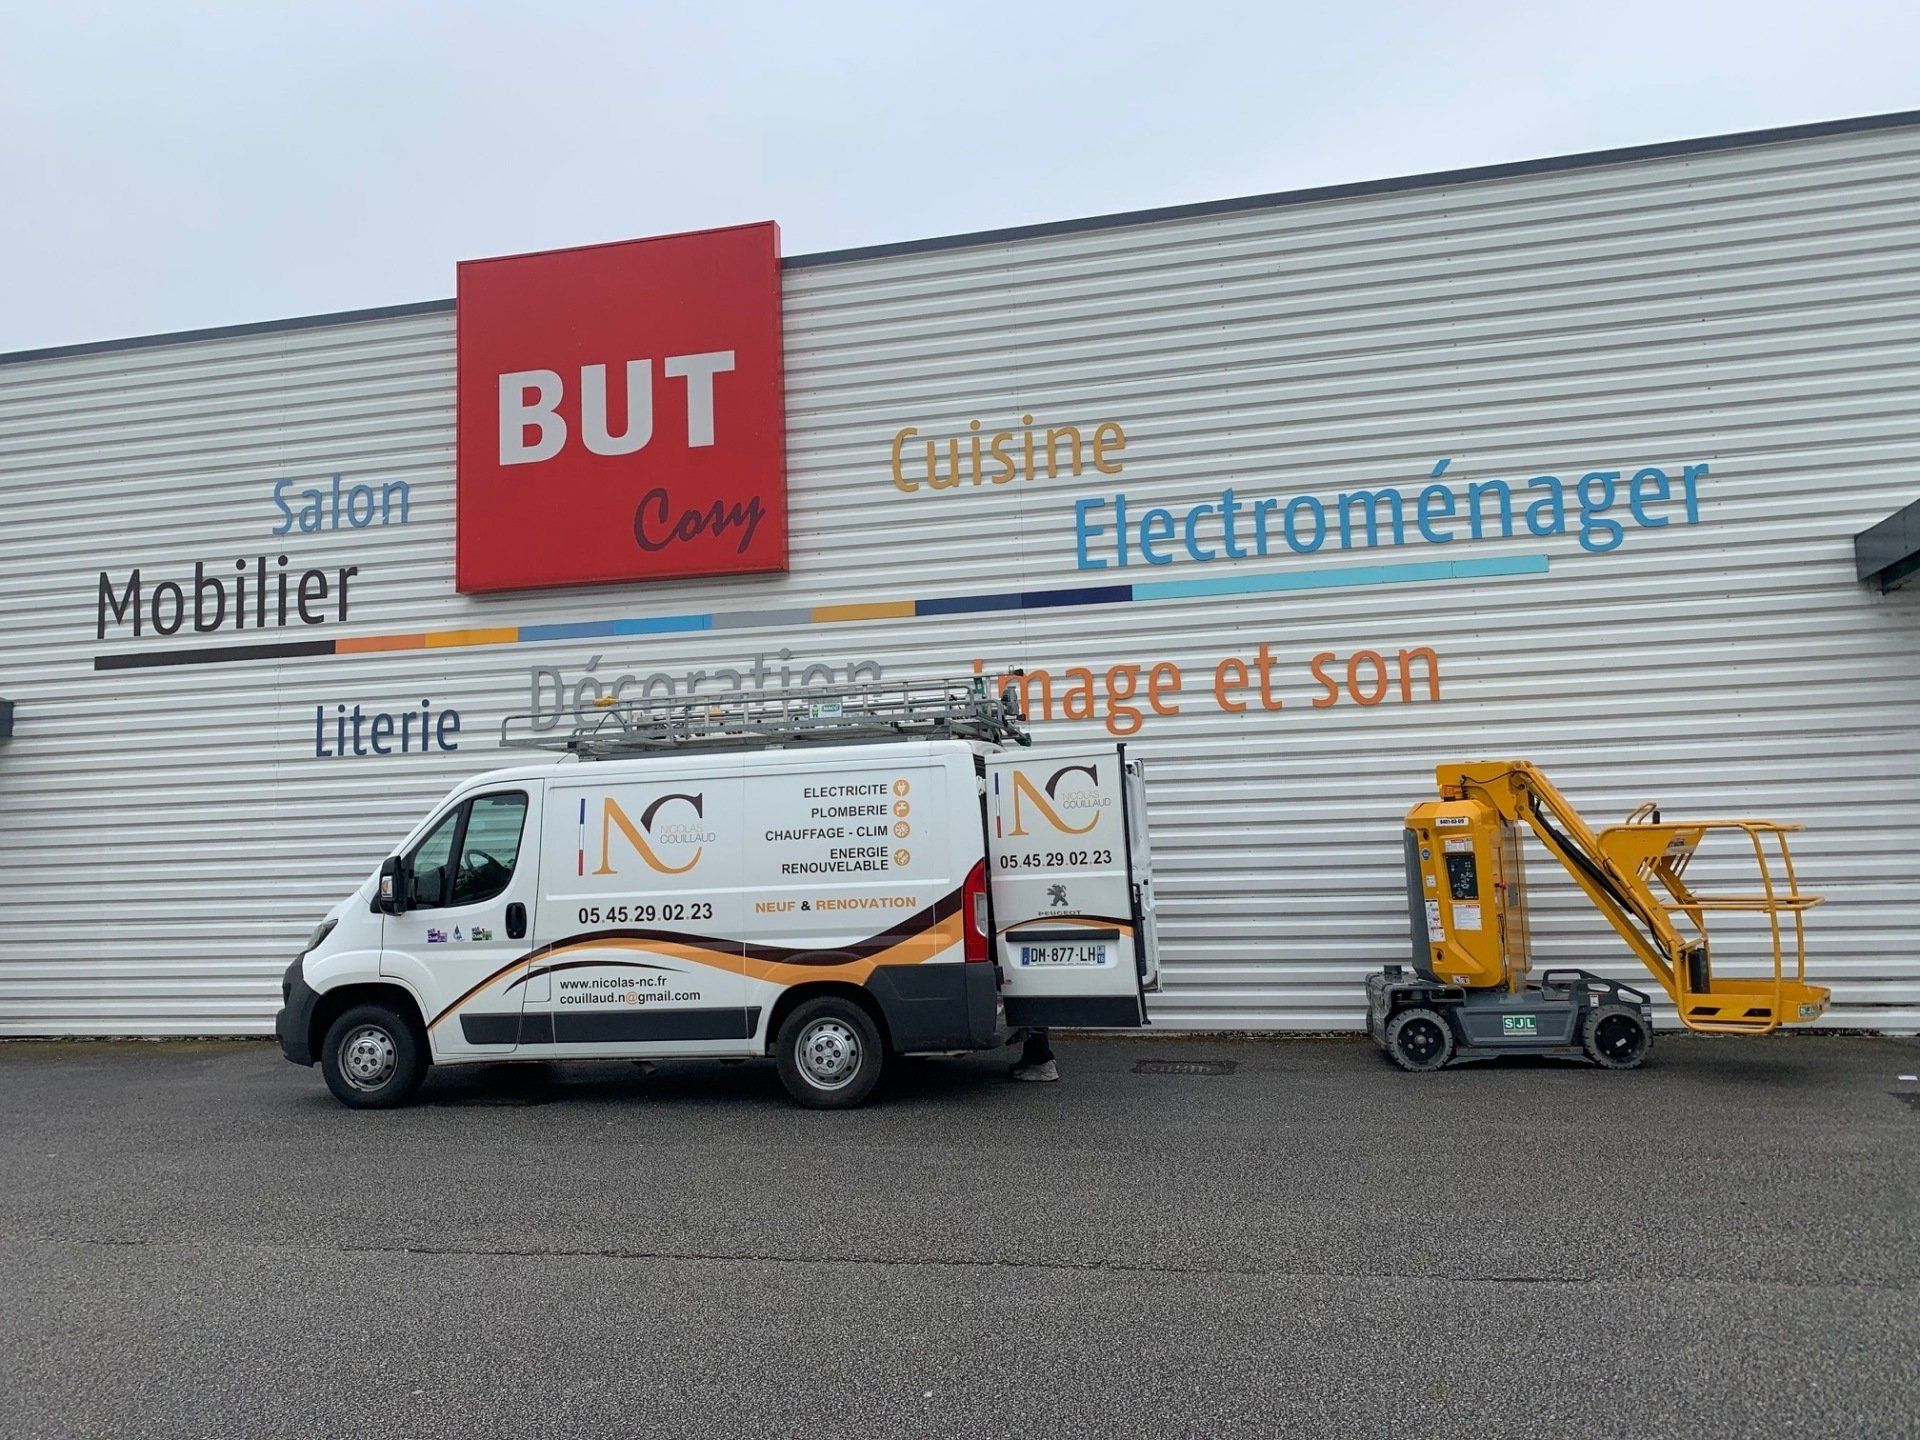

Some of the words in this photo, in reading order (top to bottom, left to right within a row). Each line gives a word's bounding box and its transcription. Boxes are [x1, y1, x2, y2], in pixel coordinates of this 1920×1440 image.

[499, 350, 735, 466] BUT
[891, 415, 1126, 493] Cuisine
[272, 473, 410, 535] Salon
[634, 488, 766, 554] Cosy
[1076, 458, 1709, 570] Electroménager
[97, 555, 358, 639] Mobilier
[1215, 642, 1283, 713] et
[1311, 646, 1440, 708] son
[316, 699, 461, 757] Literie
[803, 783, 888, 799] ELECTRICITE
[811, 804, 888, 819] PLOMBERIE
[1063, 798, 1112, 810] COUILLAUD
[660, 823, 704, 834] NICOLAS
[765, 827, 845, 842] CHAUFFAGE
[856, 825, 888, 838] CLIM
[660, 832, 716, 844] COUILLAUD
[829, 846, 888, 860] ENERGIE
[1000, 850, 1112, 868] 05.45.29.02.23
[781, 859, 889, 875] RENOUVELABLE
[578, 902, 713, 924] 05.45.29.02.23
[755, 901, 796, 913] NEUF
[800, 899, 811, 911] &
[815, 896, 917, 911] RENOVATION
[559, 975, 667, 989] www.nicolas-nc.fr
[559, 990, 701, 1005] couillaud.n@gmail.com
[1505, 1018, 1535, 1028] SJL
